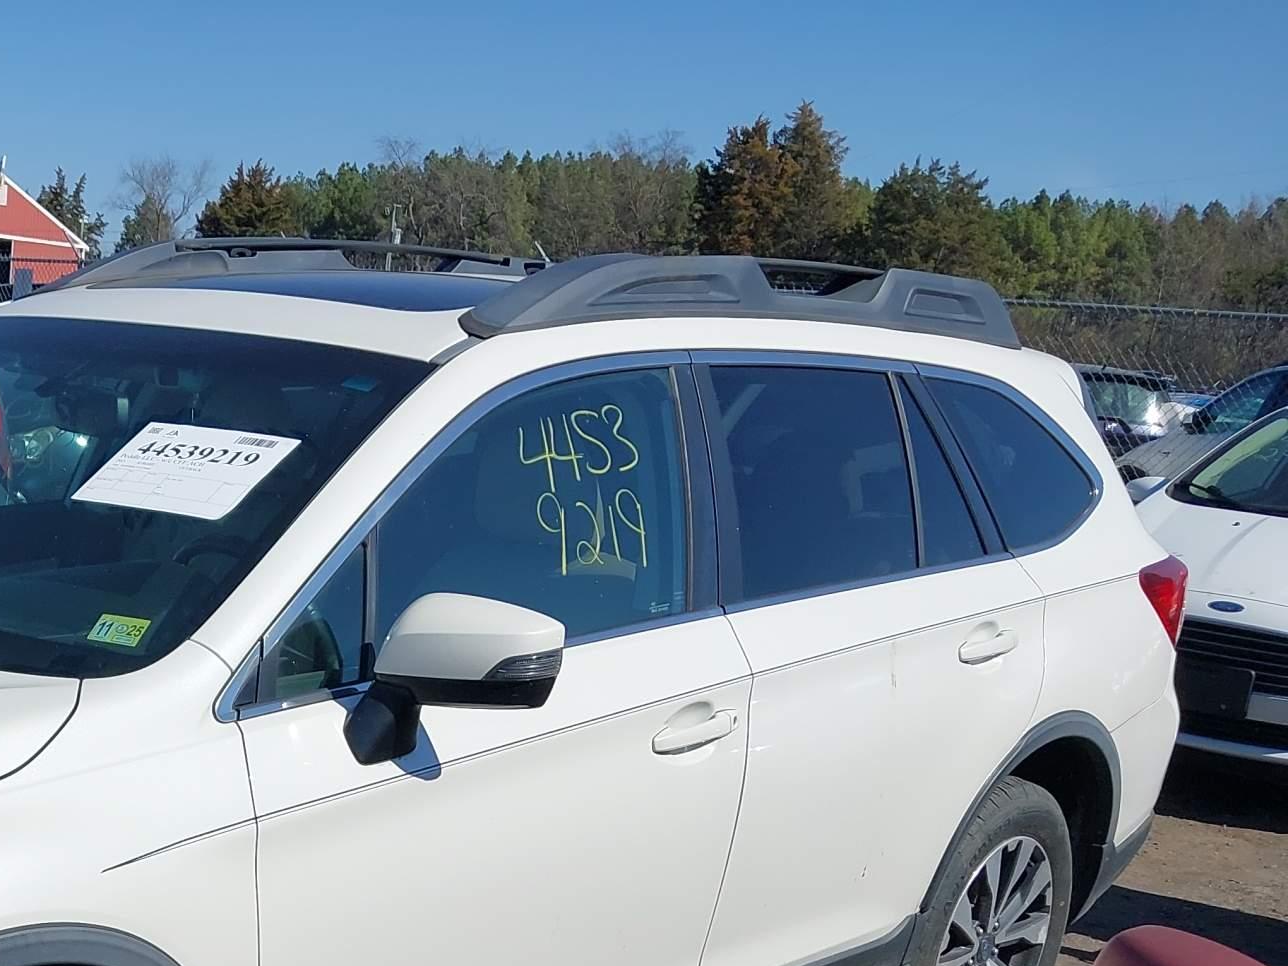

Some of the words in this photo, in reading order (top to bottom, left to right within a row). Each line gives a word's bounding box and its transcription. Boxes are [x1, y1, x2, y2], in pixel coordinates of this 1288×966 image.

[137, 440, 261, 467] 44539219
[519, 404, 639, 493] 4453
[537, 488, 647, 576] 9219
[97, 621, 114, 637] 11
[126, 625, 144, 637] 25
